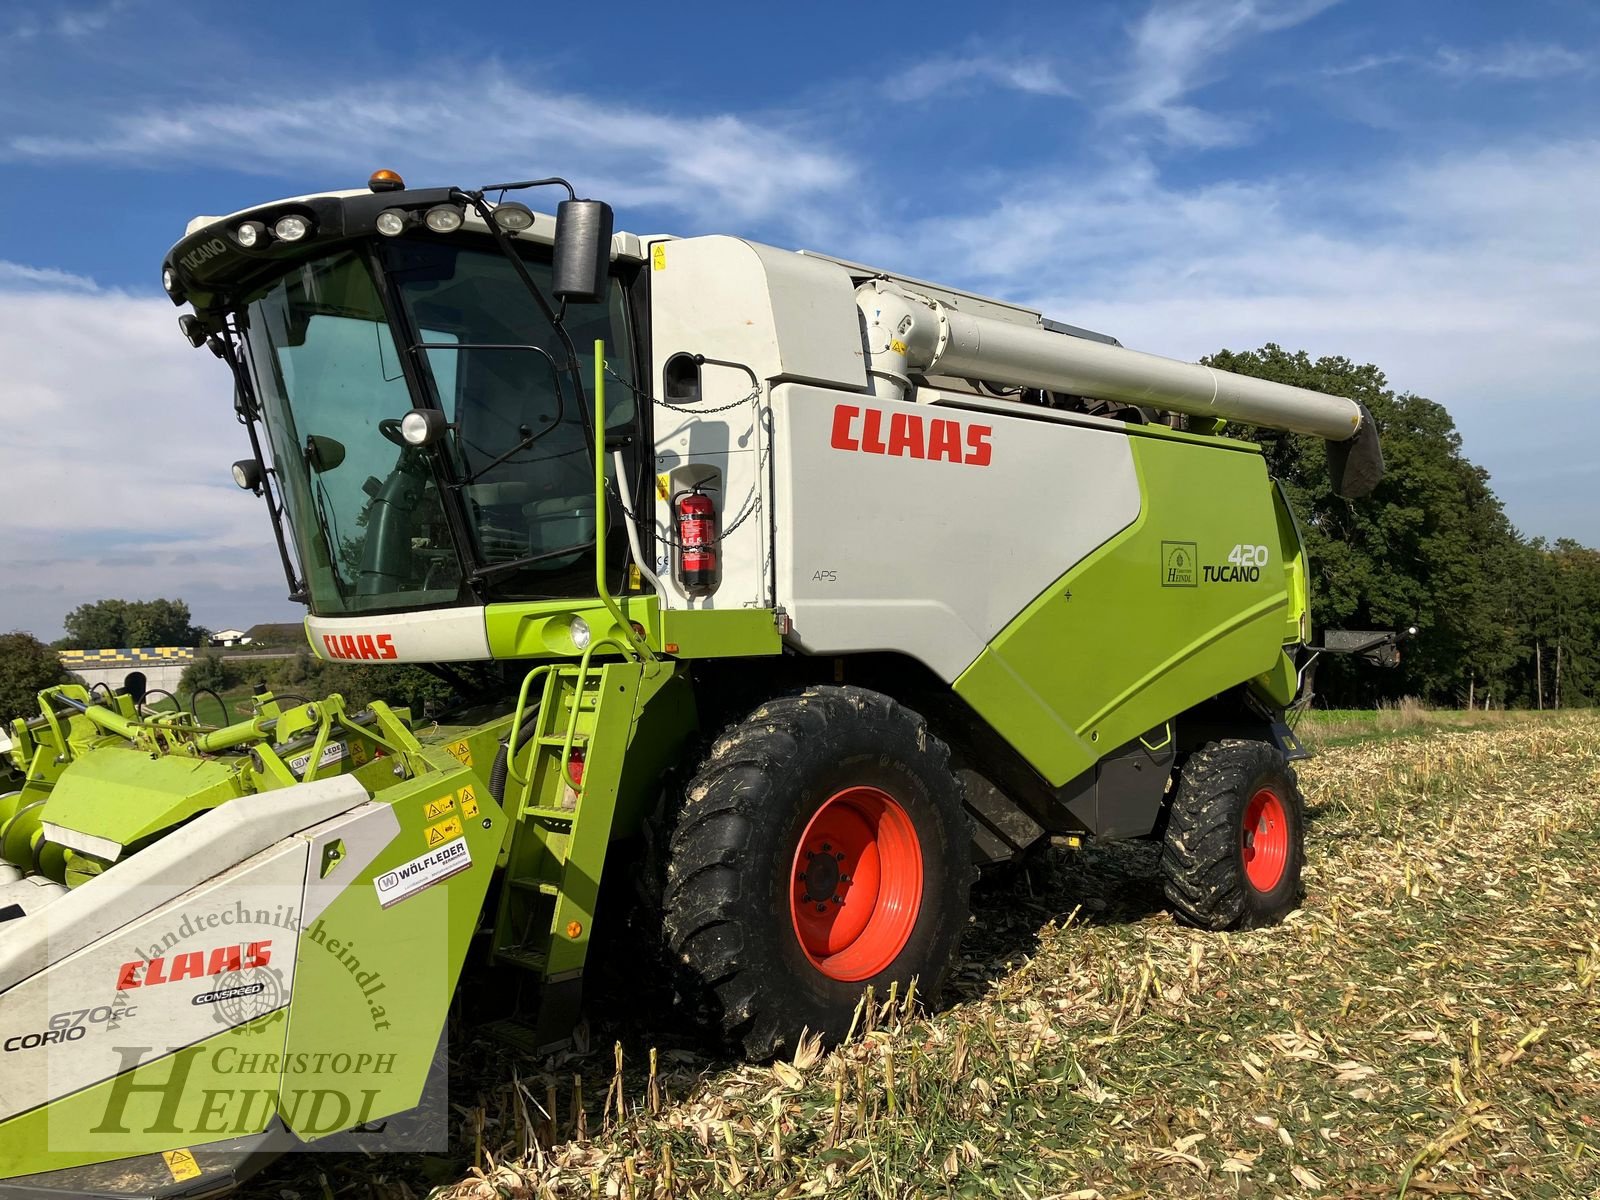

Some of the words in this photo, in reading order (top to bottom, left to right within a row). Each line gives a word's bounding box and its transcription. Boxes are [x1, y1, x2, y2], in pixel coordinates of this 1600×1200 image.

[180, 239, 227, 271] TUCANO
[831, 404, 992, 467] CLAAS
[1228, 544, 1269, 567] 420
[812, 570, 837, 582] APS
[1203, 566, 1260, 582] TUCANO
[322, 634, 398, 659] CLAAS
[399, 843, 465, 879] WÖLFLEDER
[116, 940, 272, 991] CLAAS
[196, 984, 261, 1004] CONSPEED
[4, 1026, 86, 1052] CORIO
